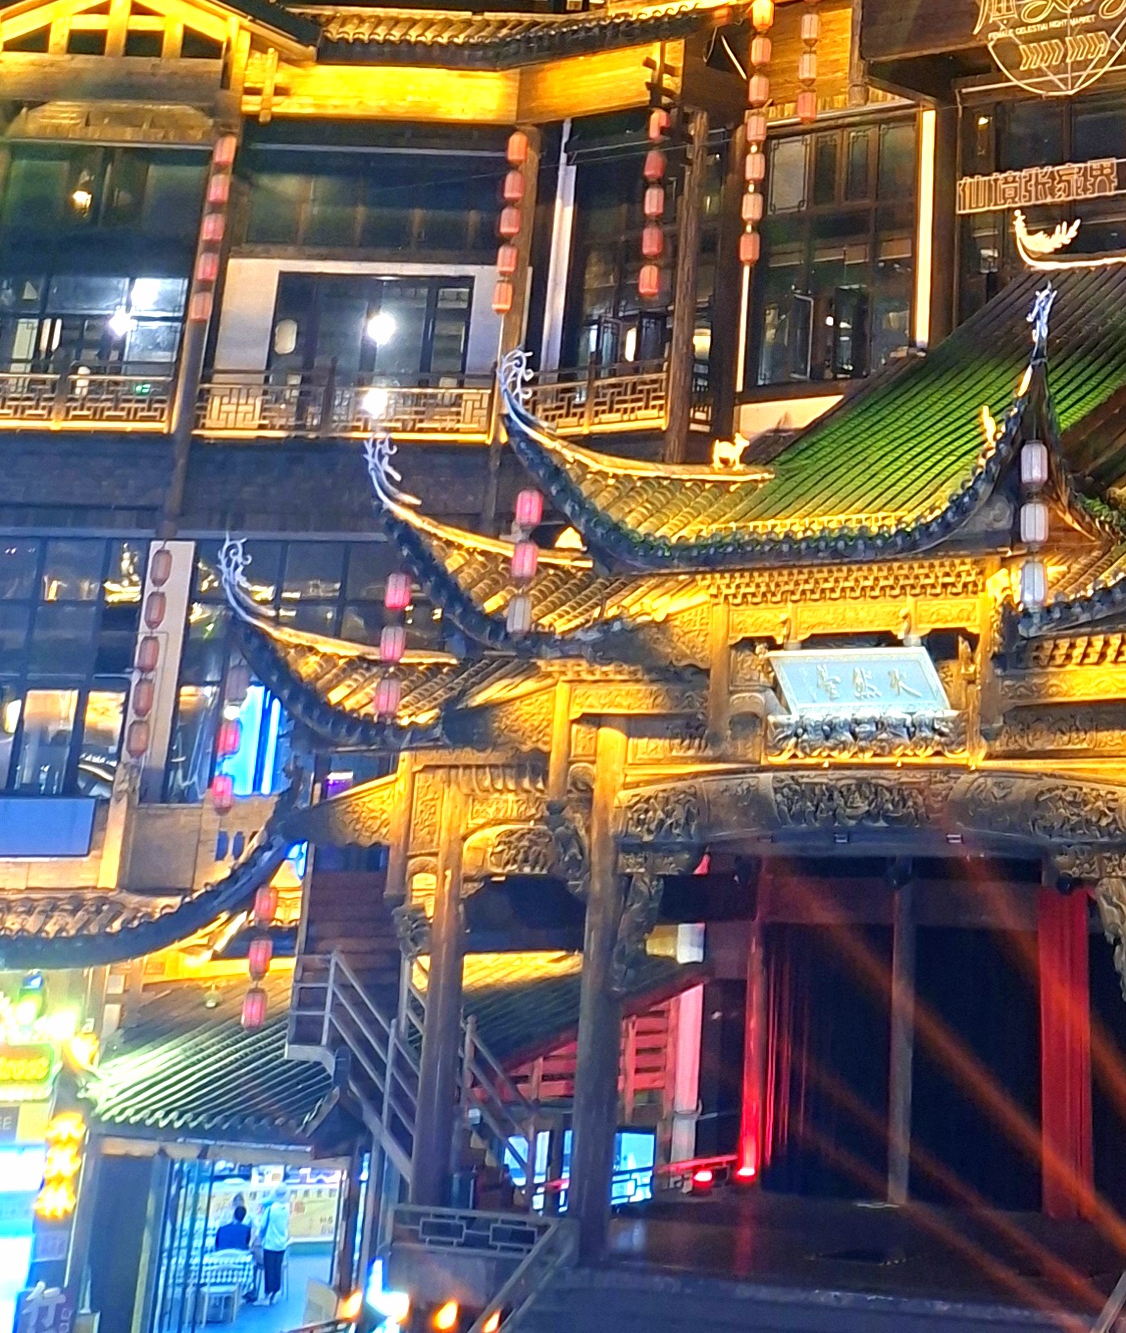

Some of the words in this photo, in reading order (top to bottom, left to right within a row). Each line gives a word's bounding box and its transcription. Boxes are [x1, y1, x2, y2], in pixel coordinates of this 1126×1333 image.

[958, 158, 1118, 214] 仙境张家界
